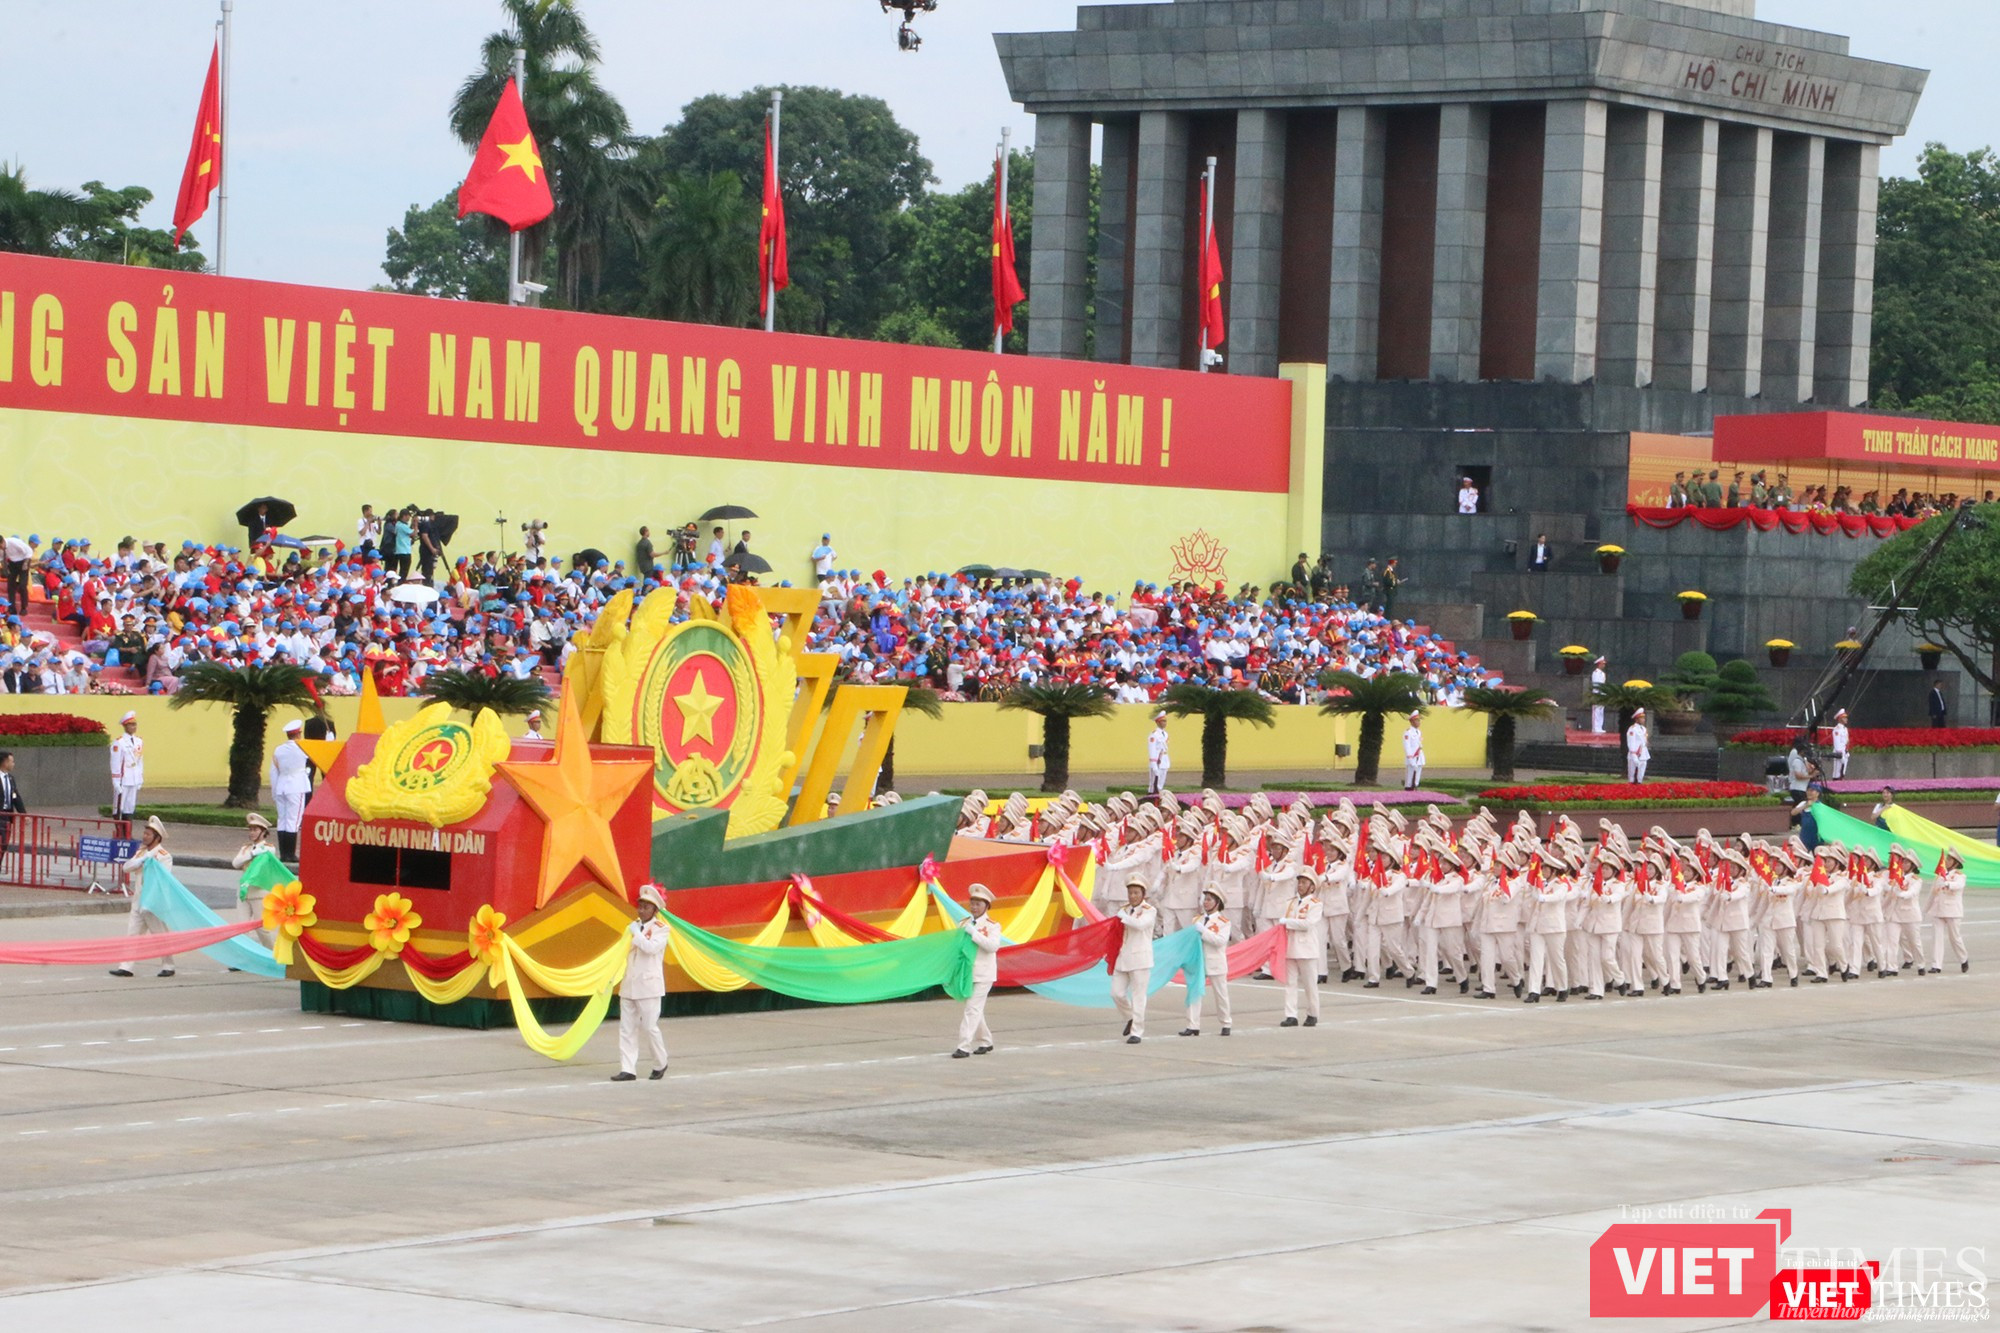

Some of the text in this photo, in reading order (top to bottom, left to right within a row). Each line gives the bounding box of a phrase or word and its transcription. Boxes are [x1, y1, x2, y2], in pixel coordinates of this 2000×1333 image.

[106, 283, 226, 399] SẢN
[263, 308, 395, 426] VIỆT
[427, 332, 541, 423] NAM
[573, 345, 742, 439] QUANG
[771, 363, 883, 448] VINH
[909, 369, 1034, 459] MUÔN
[1058, 379, 1145, 466] NĂM
[1862, 425, 1999, 465] TINH THẦN CÁCH MẠNG
[118, 847, 129, 858] A1
[314, 818, 486, 855] CỰU CÔNG AN NHÂN DÂN
